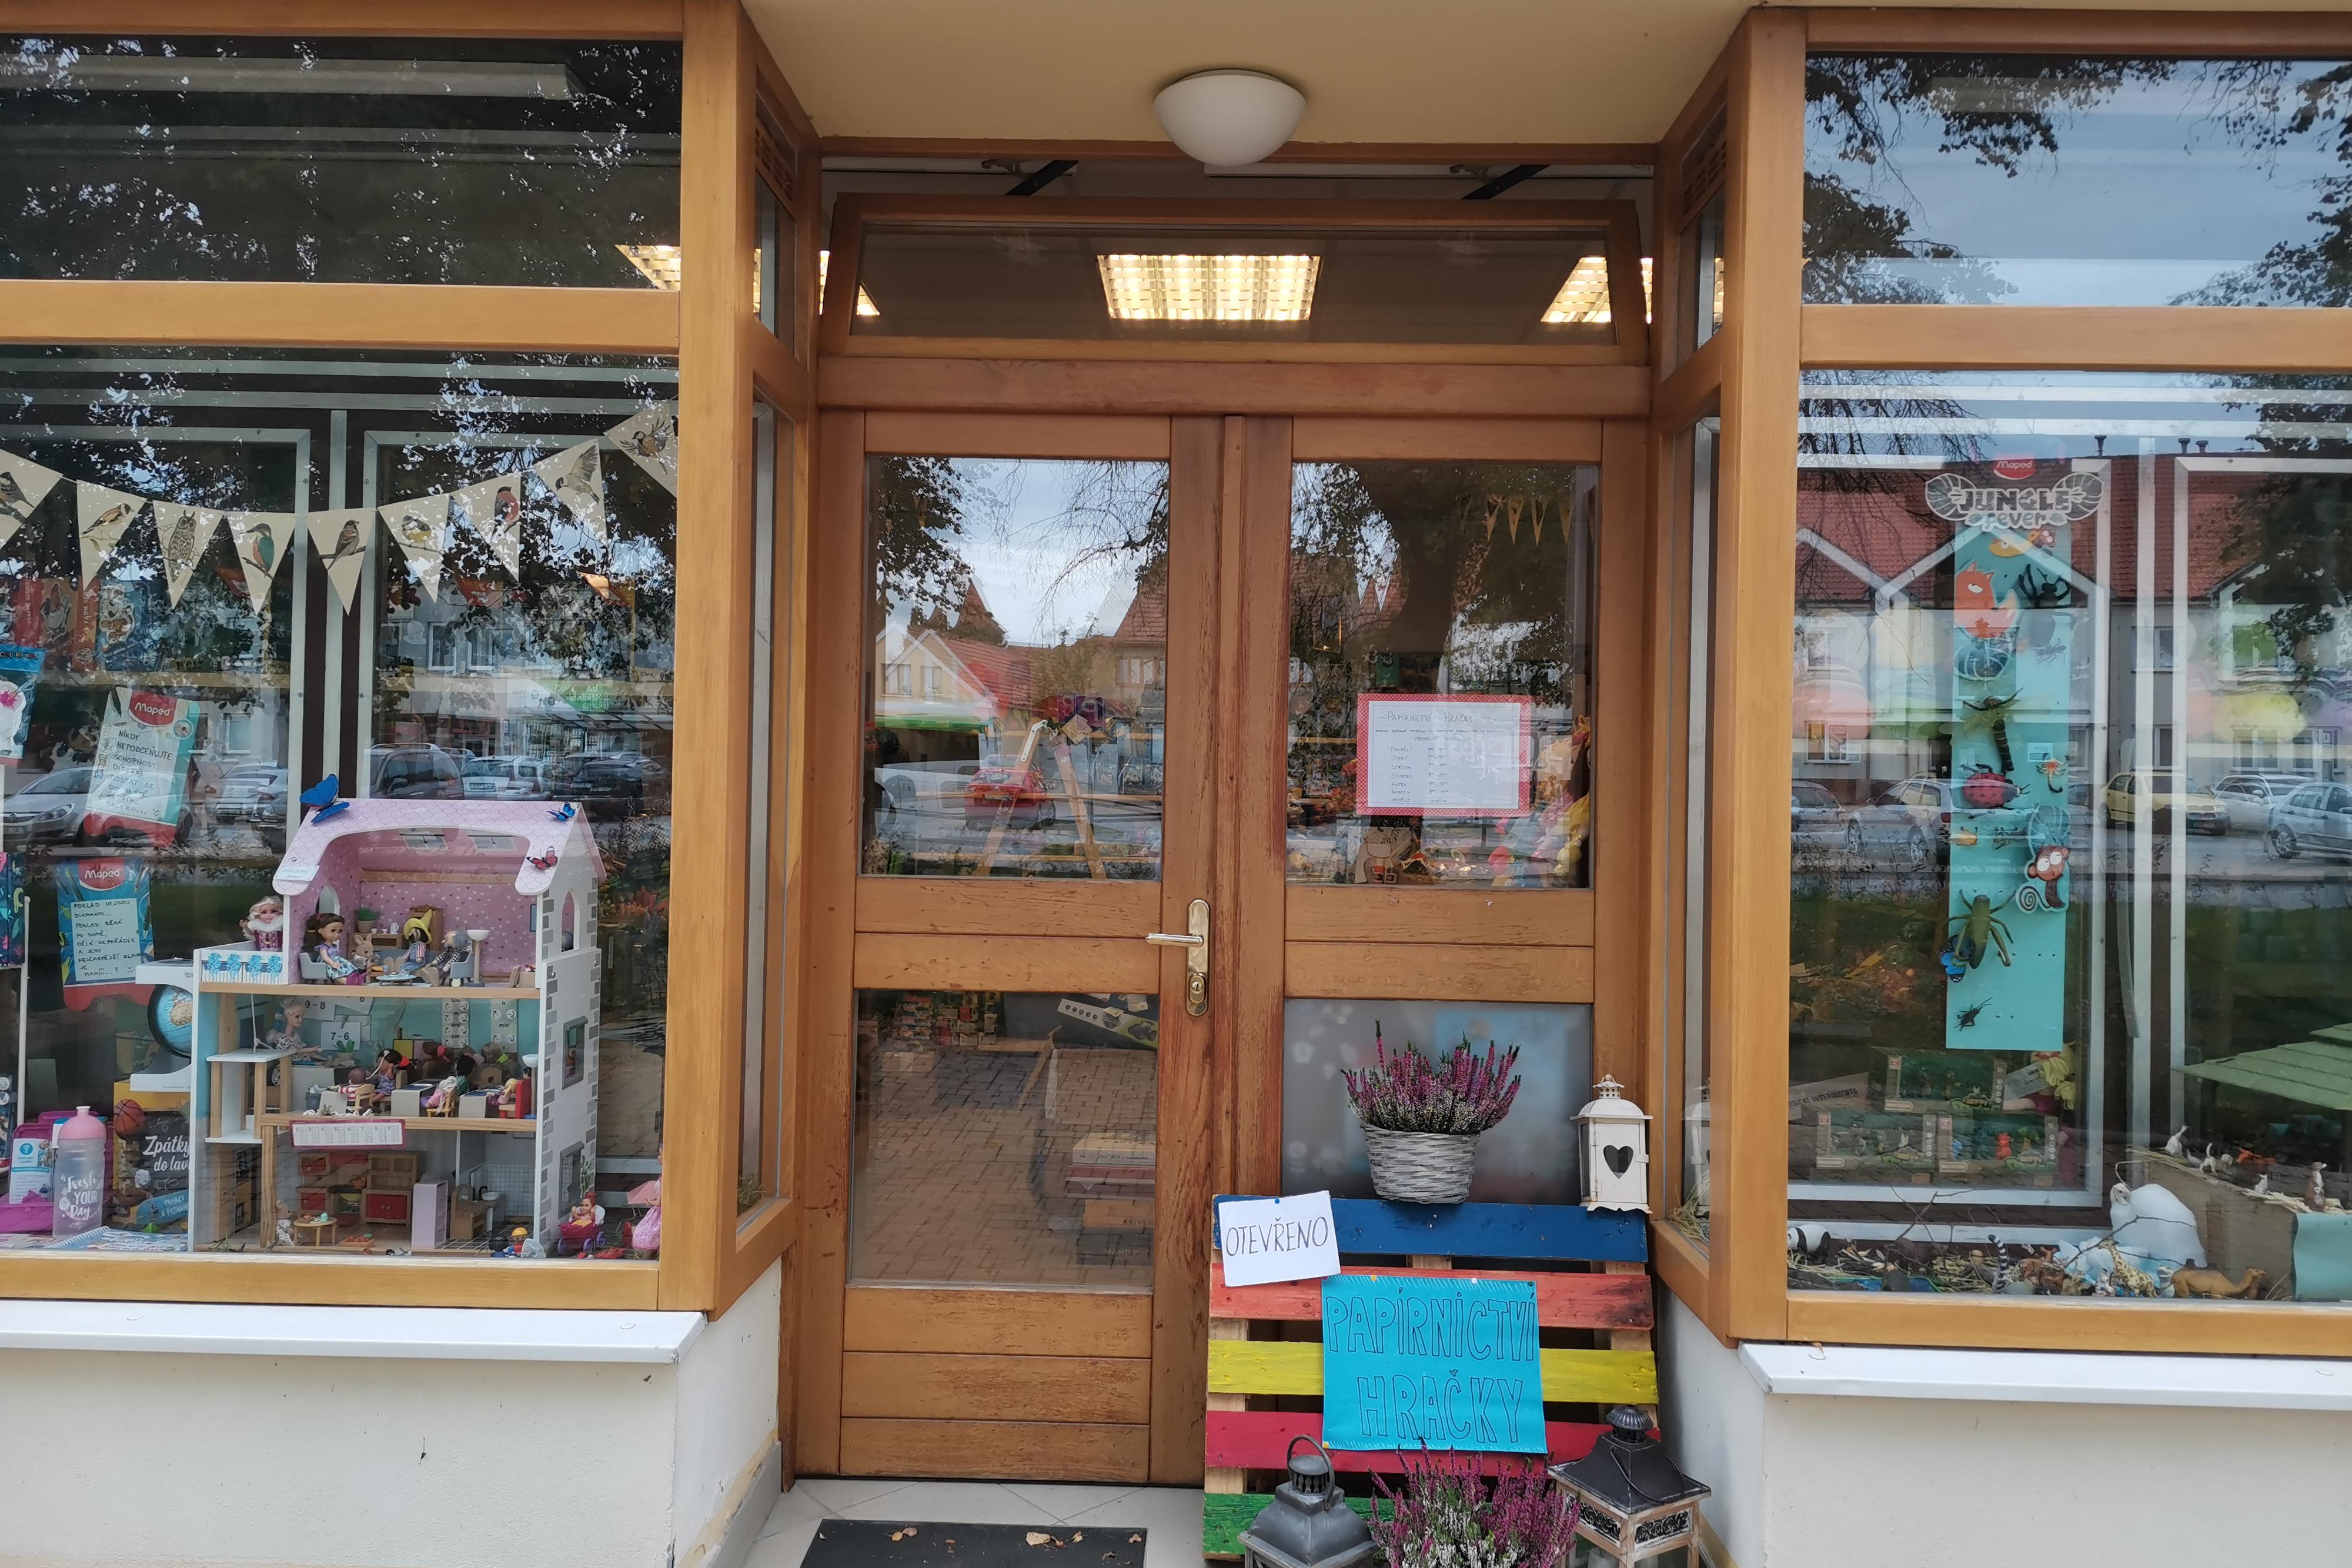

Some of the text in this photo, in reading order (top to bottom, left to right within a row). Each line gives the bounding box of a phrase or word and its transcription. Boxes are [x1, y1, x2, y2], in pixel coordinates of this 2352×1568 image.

[1959, 489, 2072, 513] JUNGLE
[134, 702, 171, 716] Maped
[1388, 710, 1433, 723] PAPÍRNICTVÍ
[117, 741, 173, 760] NEPODCEŇUJTE
[113, 754, 159, 768] SCHOPNOST
[84, 868, 121, 880] Maped
[98, 937, 136, 945] NEPOŘÁDEK
[142, 1135, 190, 1158] Zpátky
[154, 1155, 189, 1172] do lav
[68, 1170, 96, 1193] Fresh
[74, 1190, 98, 1205] YOUR
[70, 1205, 93, 1221] Day
[1226, 1216, 1329, 1257] OTEVŘENO
[1325, 1286, 1536, 1362] PAPÍRNICTVÍ
[1357, 1368, 1523, 1444] HRAČKY
